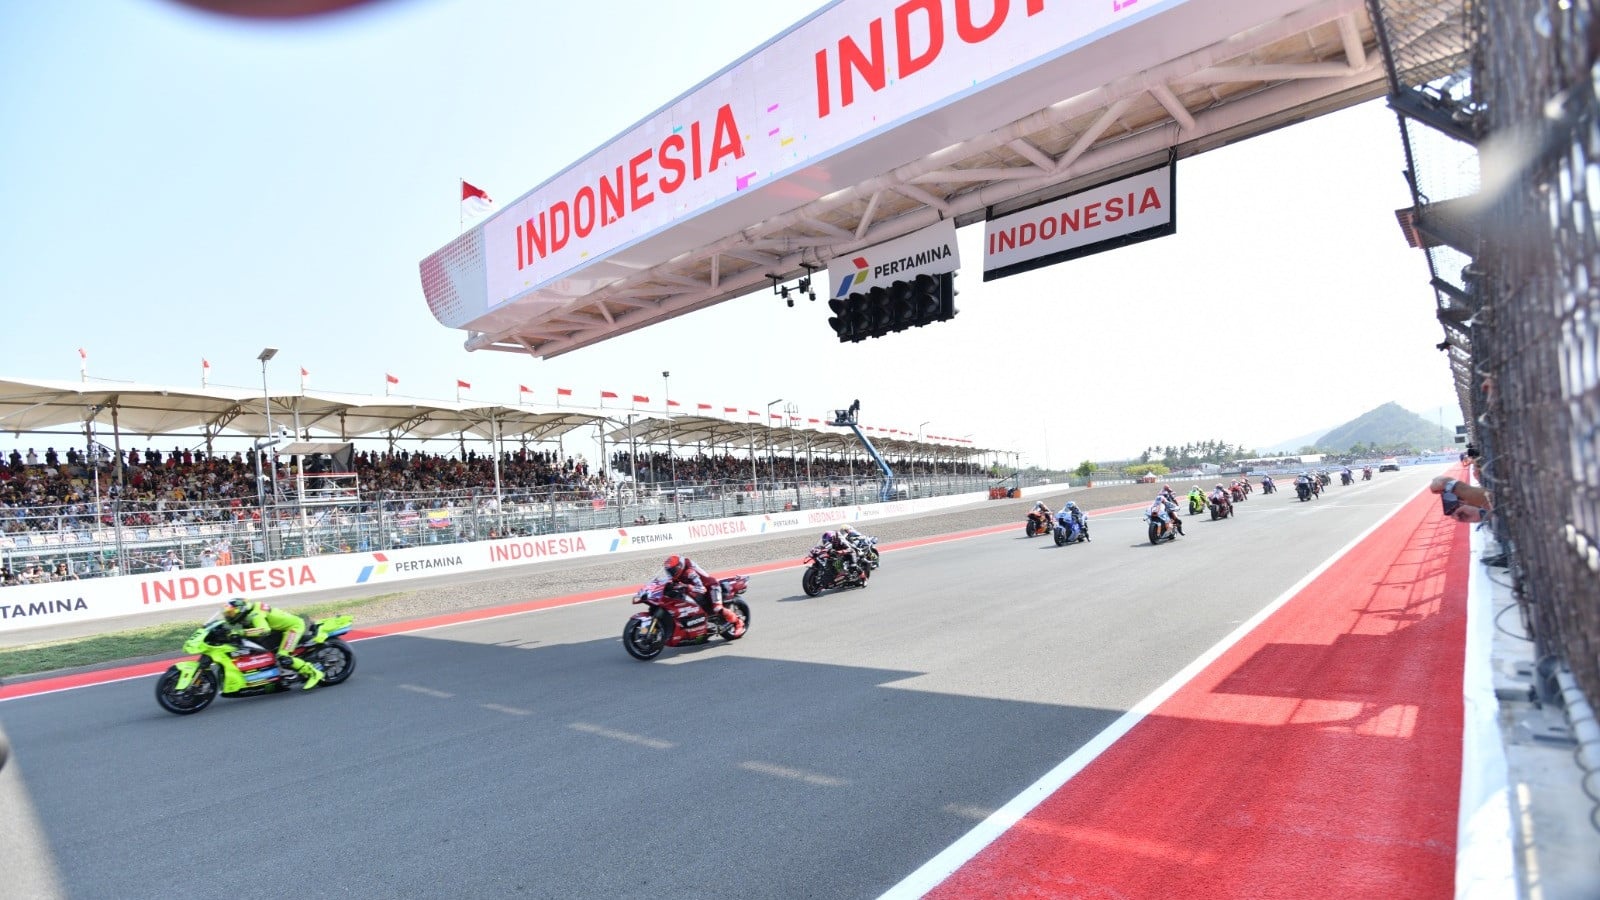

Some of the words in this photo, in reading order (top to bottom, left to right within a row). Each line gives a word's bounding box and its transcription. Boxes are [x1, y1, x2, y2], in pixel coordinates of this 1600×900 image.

[516, 103, 746, 271] INDONESIA
[989, 187, 1162, 255] INDONESIA
[874, 243, 952, 279] PERTAMINA
[632, 533, 673, 544] PERTAMINA
[688, 520, 747, 539] INDONESIA
[489, 536, 586, 562] INDONESIA
[395, 556, 463, 572] PERTAMINA
[141, 565, 316, 604] INDONESIA
[0, 597, 88, 619] TAMINA
